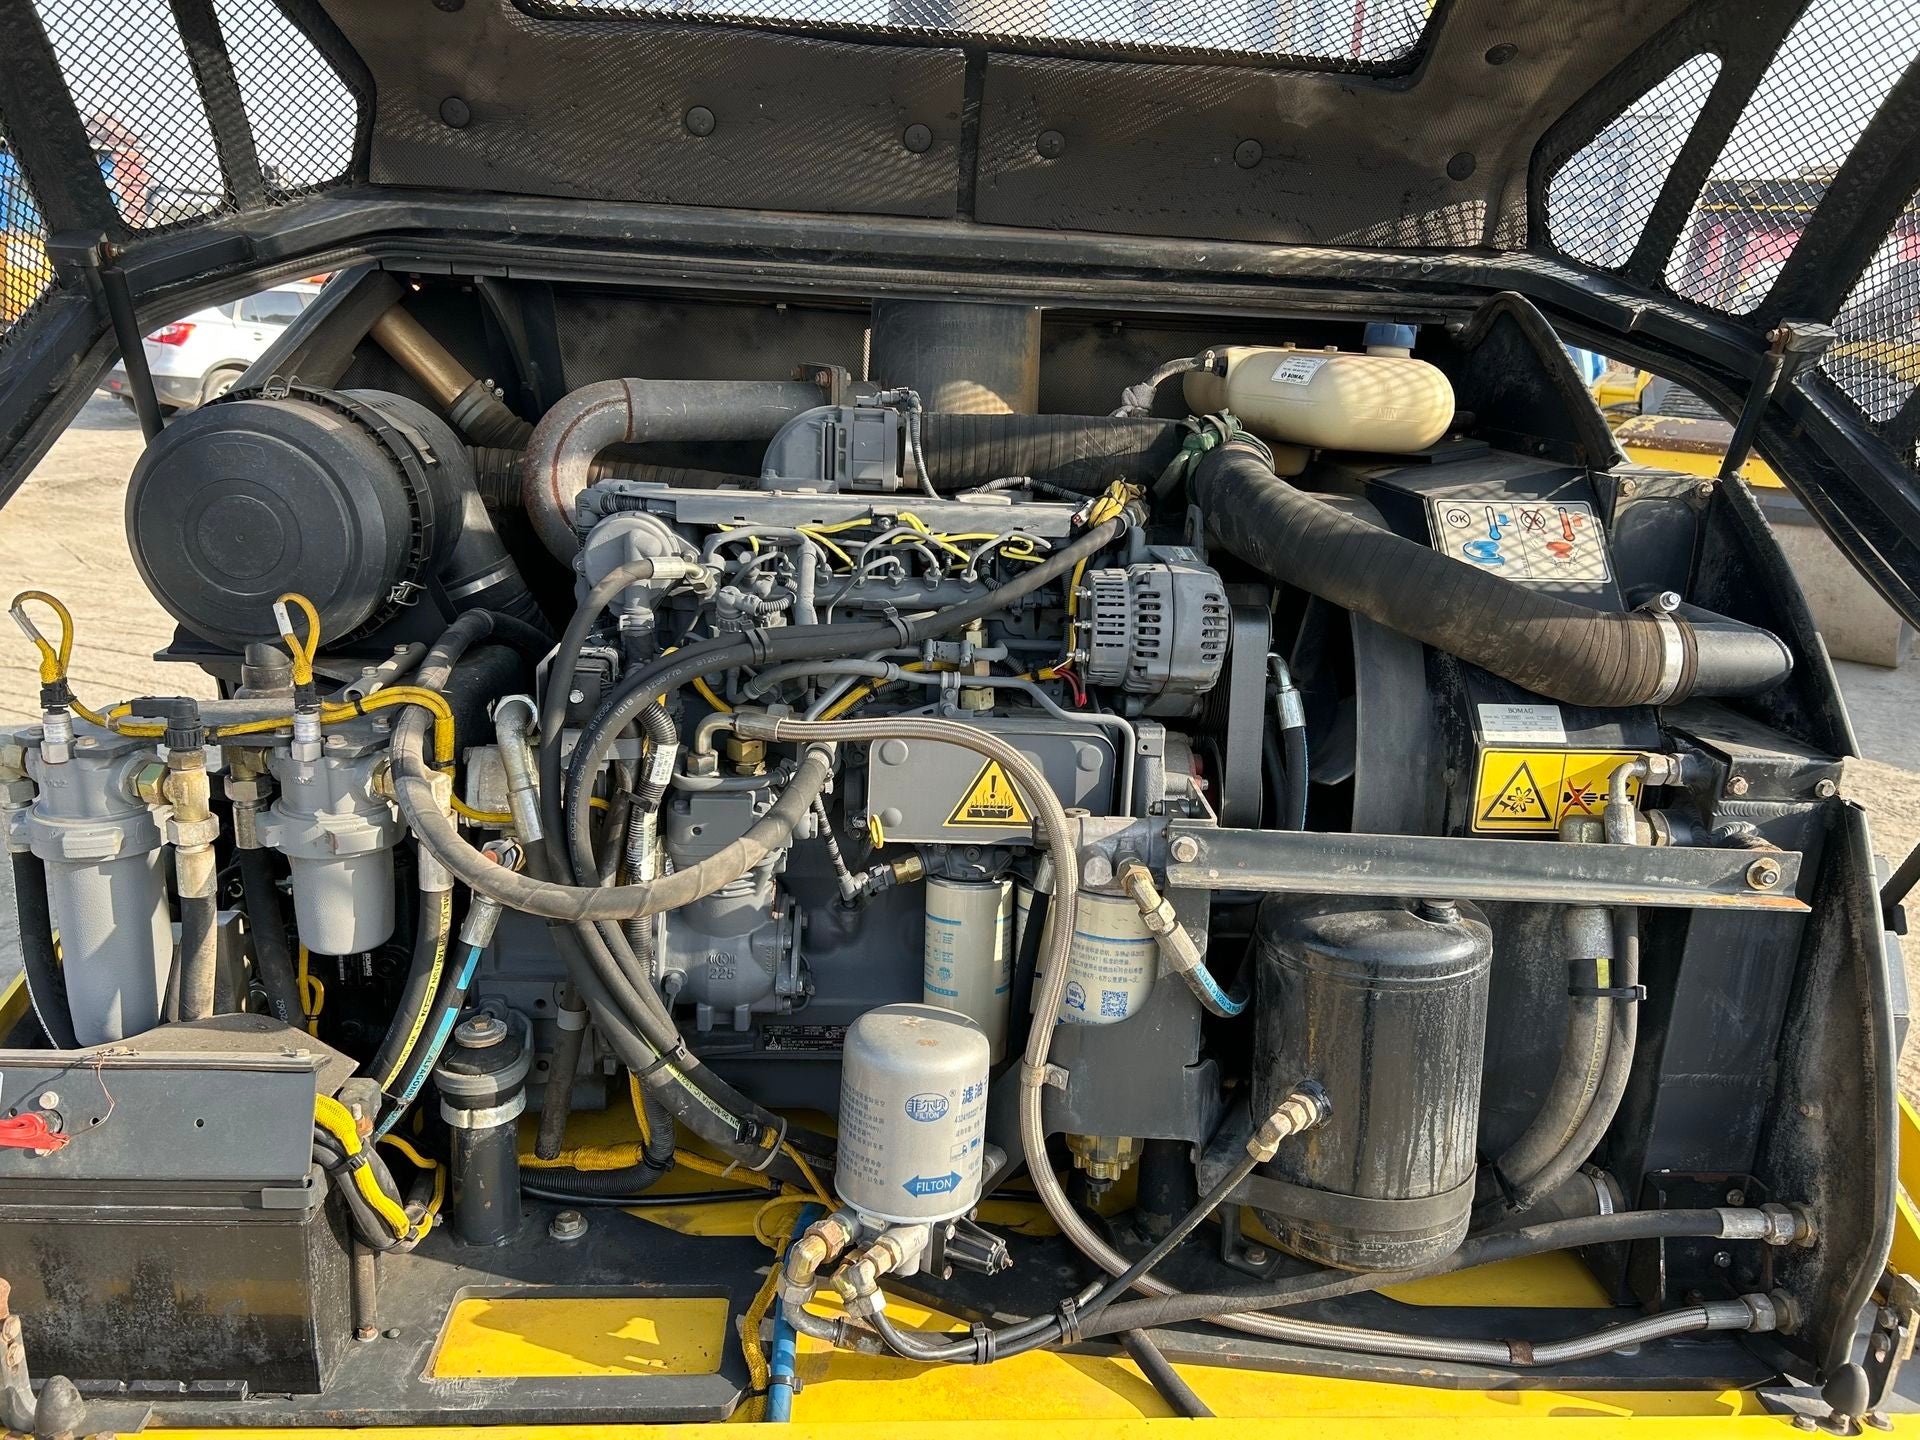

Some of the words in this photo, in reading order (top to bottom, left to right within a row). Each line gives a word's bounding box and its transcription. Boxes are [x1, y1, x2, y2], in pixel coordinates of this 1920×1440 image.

[1450, 514, 1468, 524] OK
[365, 952, 373, 977] BOMAG
[709, 967, 736, 980] 225
[915, 1111, 940, 1120] FILTON
[916, 1177, 952, 1192] FILTON
